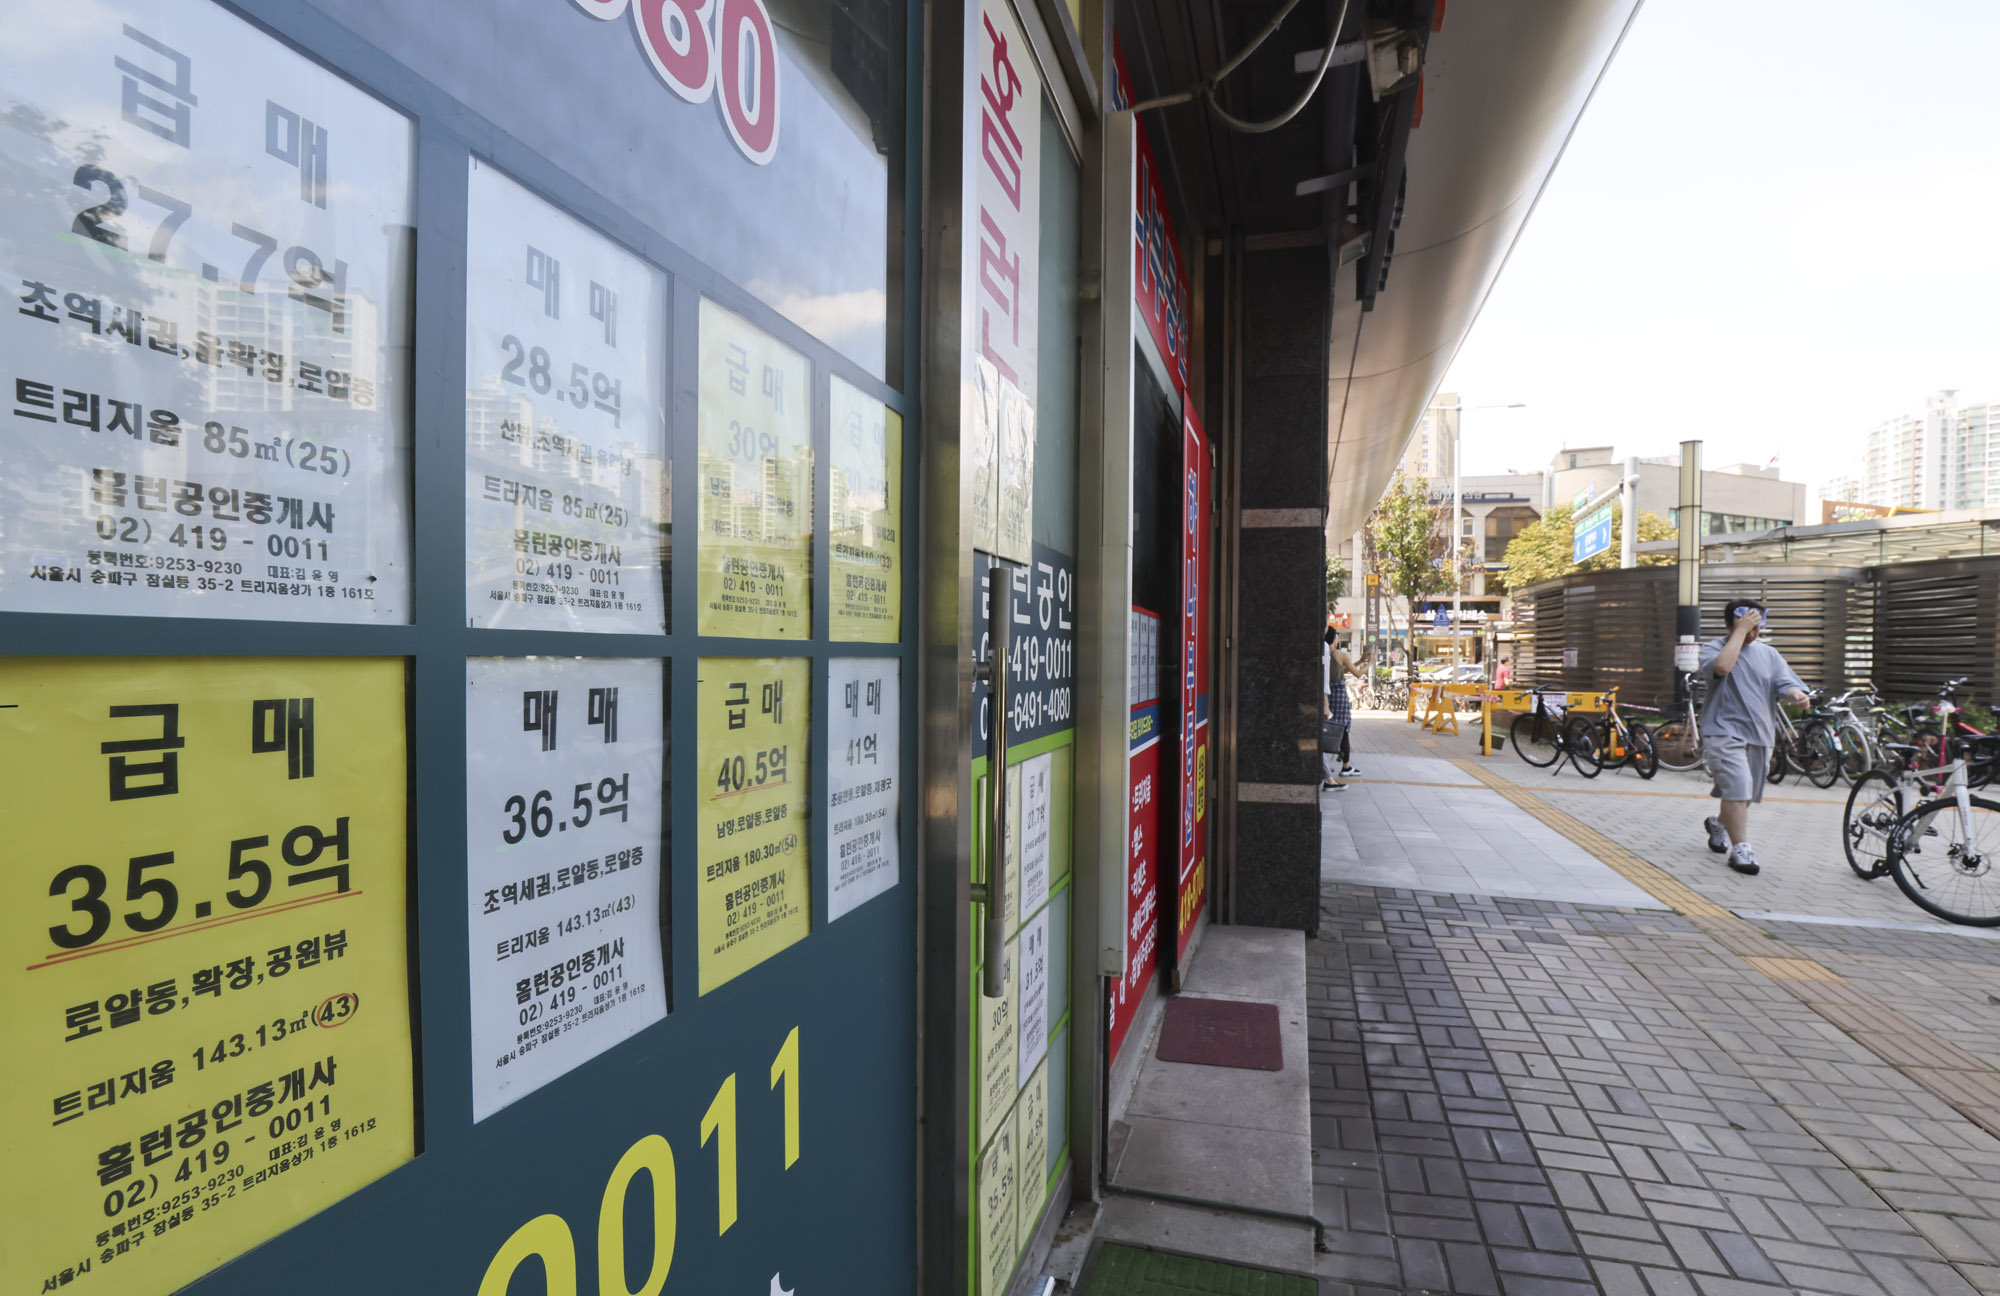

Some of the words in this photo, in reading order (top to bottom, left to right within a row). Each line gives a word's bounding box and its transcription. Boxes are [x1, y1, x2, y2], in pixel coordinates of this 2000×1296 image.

[114, 22, 198, 150] 급
[265, 98, 328, 211] 매
[71, 163, 348, 335] 27.7억
[13, 377, 182, 447] 트리지움
[501, 334, 621, 429] 28.5억
[728, 419, 780, 476] 30억
[91, 467, 335, 534] 홈런공인중개사
[483, 475, 553, 513] 트리지움
[513, 529, 621, 566] 홈런공인중개사
[30, 565, 81, 583] 서울시
[91, 569, 138, 586] 송파구
[146, 572, 190, 589] 잠실동
[197, 577, 234, 592] 35-2
[241, 580, 312, 597] 트리지움상가
[341, 587, 375, 600] 161호
[100, 703, 185, 802] 급
[252, 697, 315, 780] 매
[717, 745, 788, 793] 40.5억
[846, 733, 877, 766] 41억
[502, 772, 629, 845] 36.5억
[717, 803, 788, 840] 남향,로얄동,로얄층
[706, 855, 741, 883] 트리지움
[840, 829, 881, 859] 홈런공인중개사
[48, 816, 350, 949] 35.5억
[483, 846, 643, 915] 초역세권,로얄동,로얄층
[725, 869, 786, 912] 홈런공인중개사
[496, 926, 550, 962] 트리지움
[515, 936, 625, 1005] 홈런공인중개사
[64, 929, 348, 1043] 로얄동,확장,공원뷰
[495, 1050, 516, 1069] 서울시
[518, 1039, 538, 1056] 송파구
[541, 1026, 560, 1043] 잠실동
[563, 1017, 580, 1032] 35-2
[52, 1059, 176, 1127] 트리지움
[96, 1056, 337, 1187] 홈런공인중개사
[41, 1257, 91, 1295] 서울시
[99, 1231, 145, 1265] 송파구
[153, 1206, 195, 1237] 잠실동
[201, 1185, 237, 1211] 35-2
[242, 1146, 315, 1192] 트리지움상가
[320, 1136, 338, 1153] 1층
[343, 1117, 377, 1141] 161호
[95, 1164, 245, 1247] 등록번호:9253-9230
